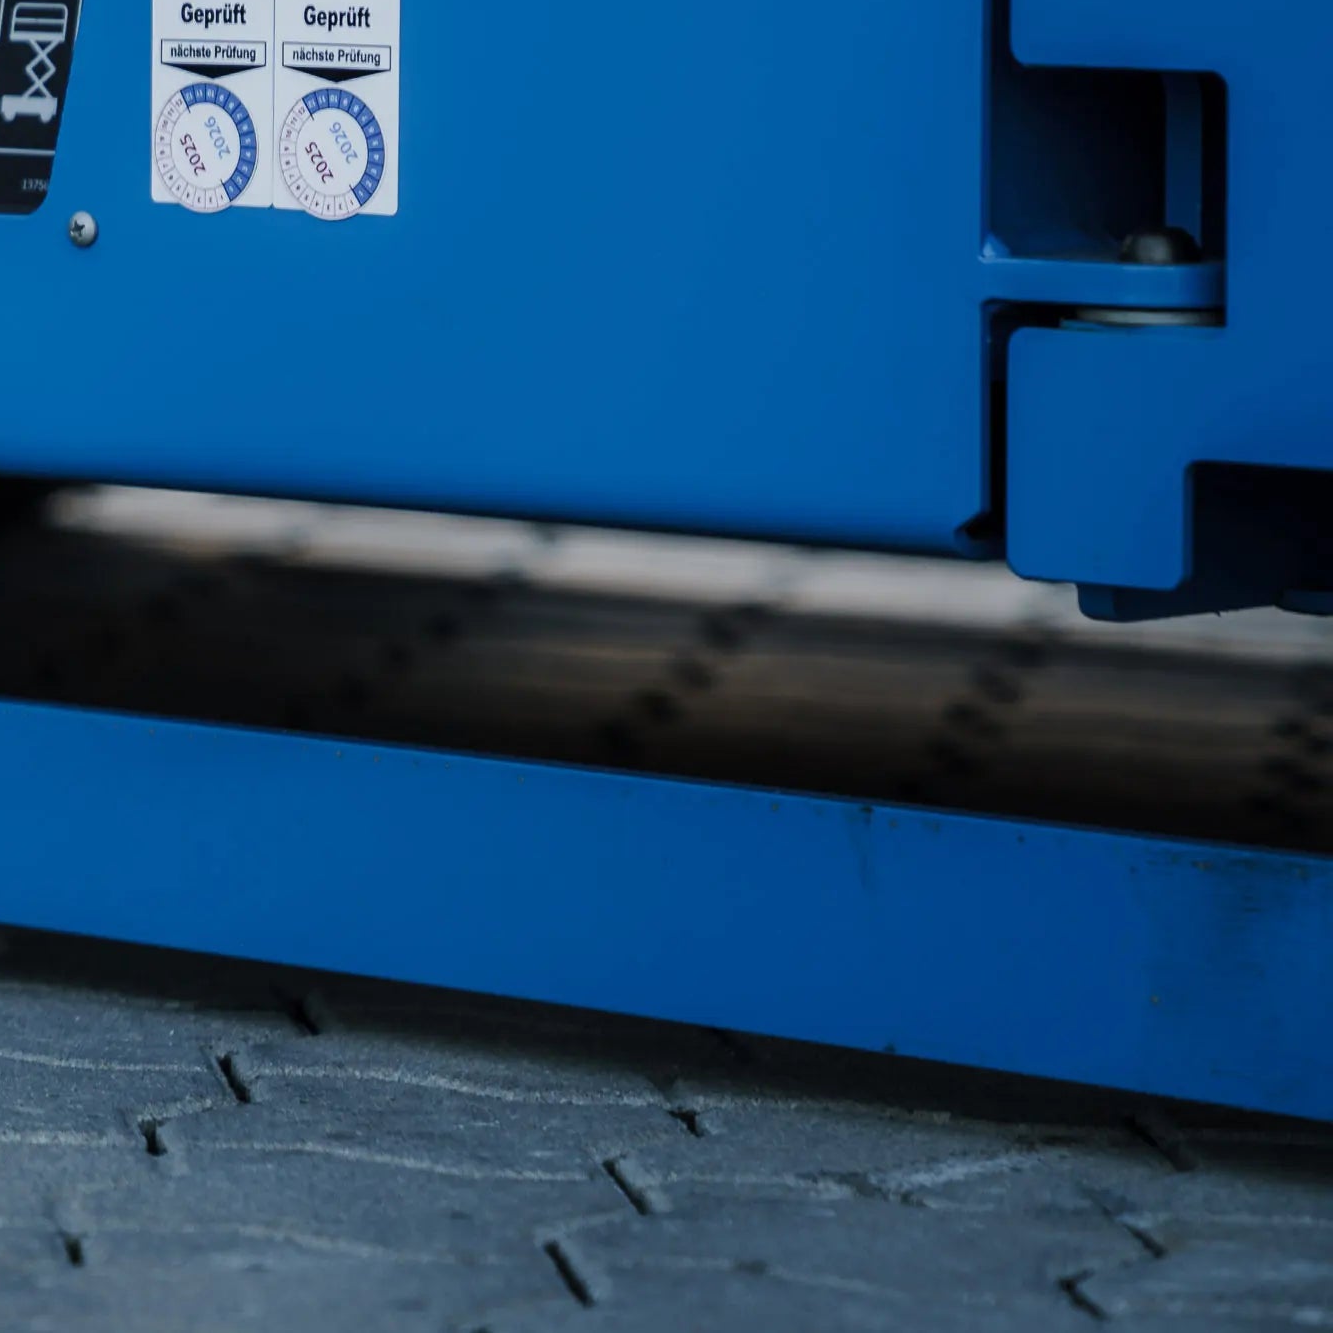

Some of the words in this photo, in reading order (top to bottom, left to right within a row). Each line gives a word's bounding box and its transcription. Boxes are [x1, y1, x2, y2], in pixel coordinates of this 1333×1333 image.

[180, 2, 247, 28] Geprüft
[303, 5, 371, 31] Geprüft
[170, 45, 211, 59] nächste
[214, 45, 256, 63] Prüfung
[292, 48, 334, 62] nächste
[337, 49, 381, 66] Prüfung
[179, 133, 206, 177] 2025
[204, 116, 231, 160] 2026
[329, 122, 358, 164] 2026
[305, 142, 334, 184] 2025
